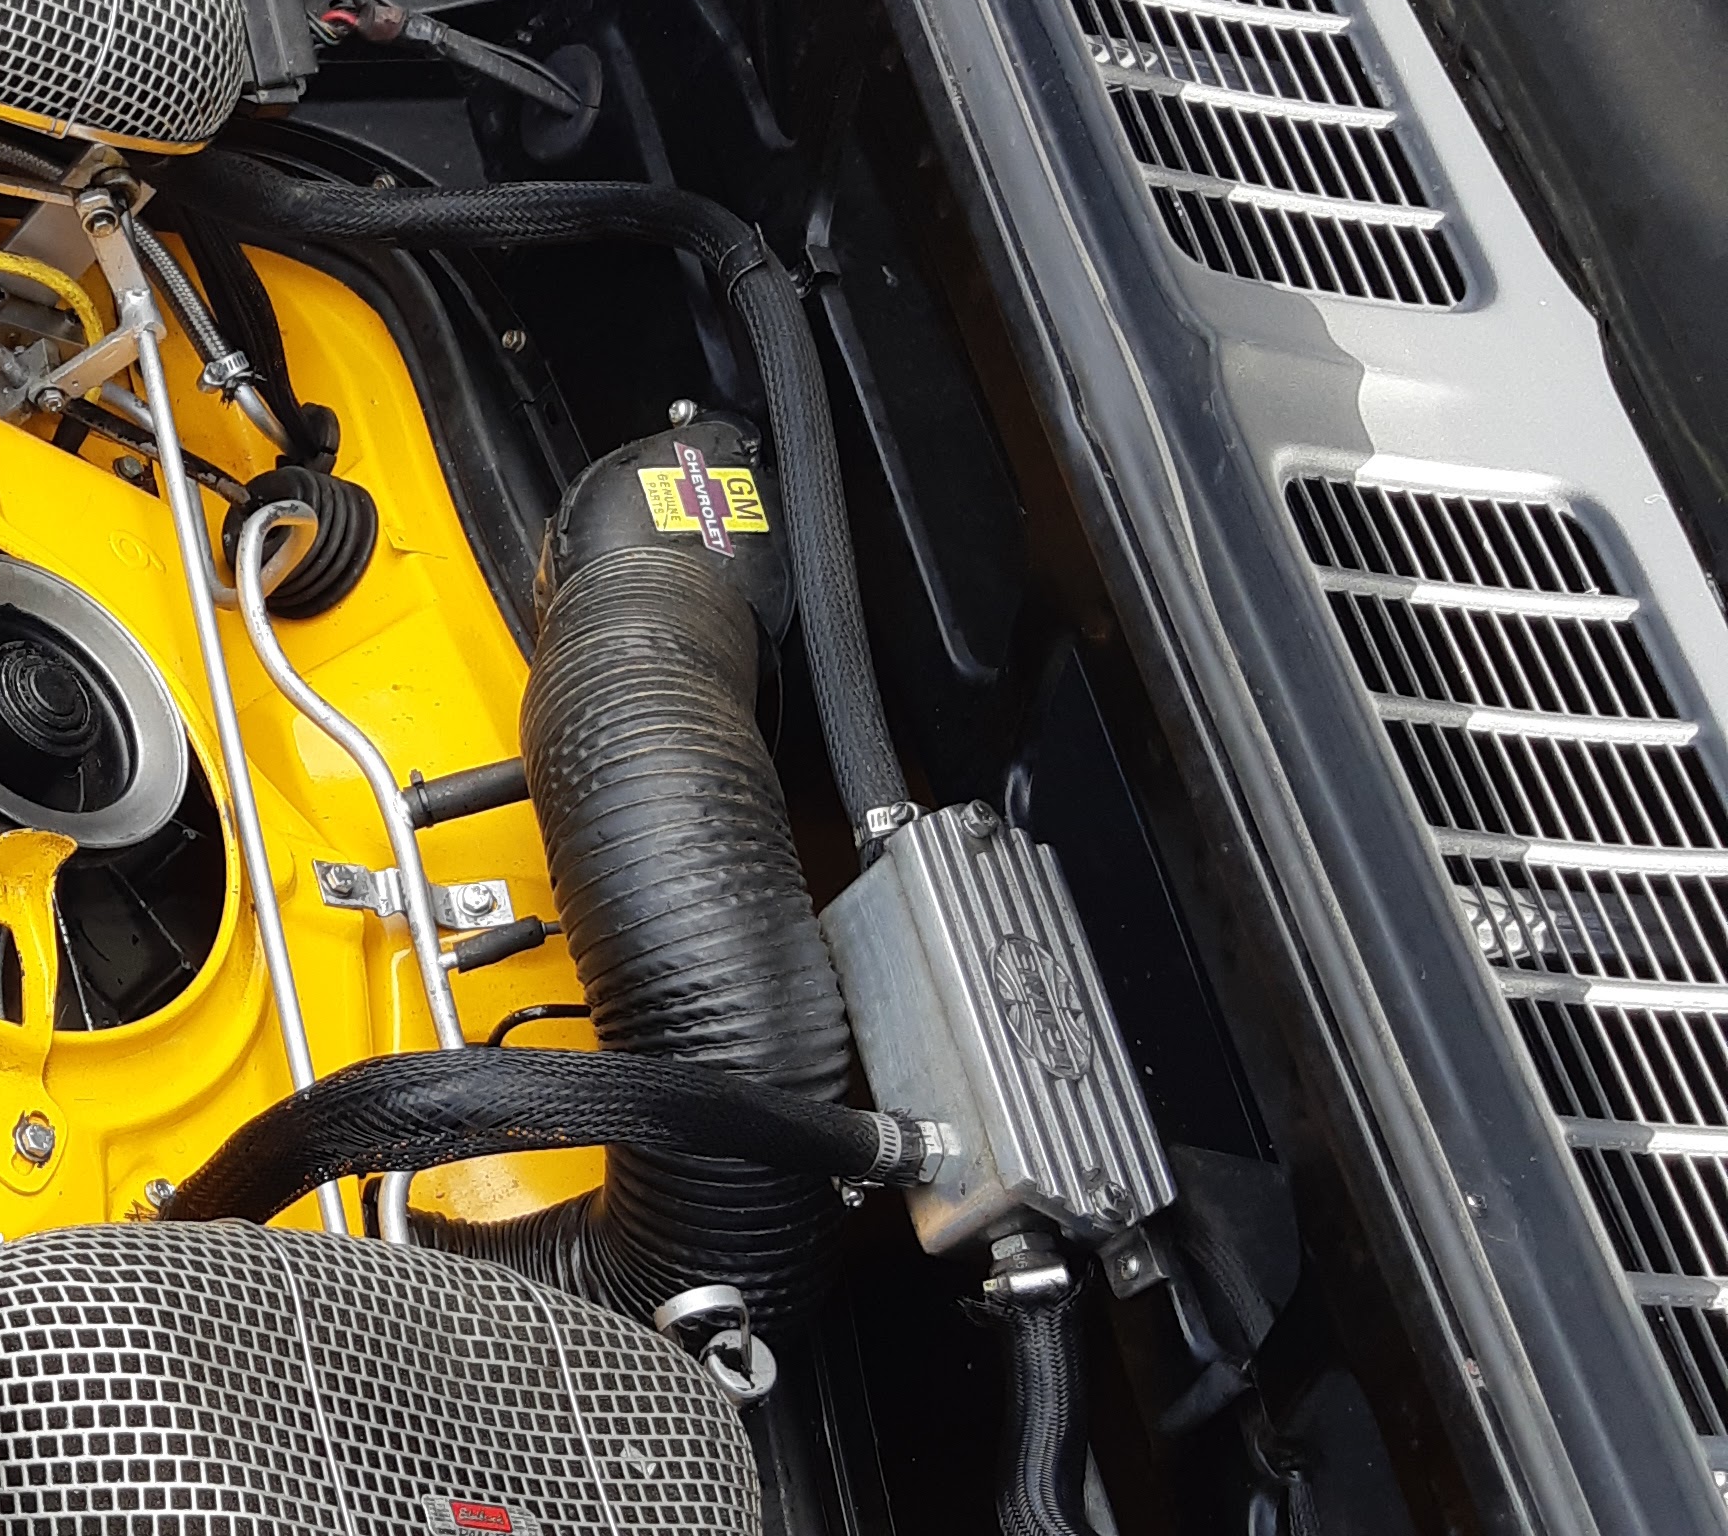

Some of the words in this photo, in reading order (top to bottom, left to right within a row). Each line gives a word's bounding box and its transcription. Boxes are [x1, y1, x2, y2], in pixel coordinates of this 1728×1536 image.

[646, 482, 665, 515] PARTS
[657, 473, 682, 522] GENUINE
[683, 449, 725, 548] CHEVROLET
[726, 477, 764, 521] GM
